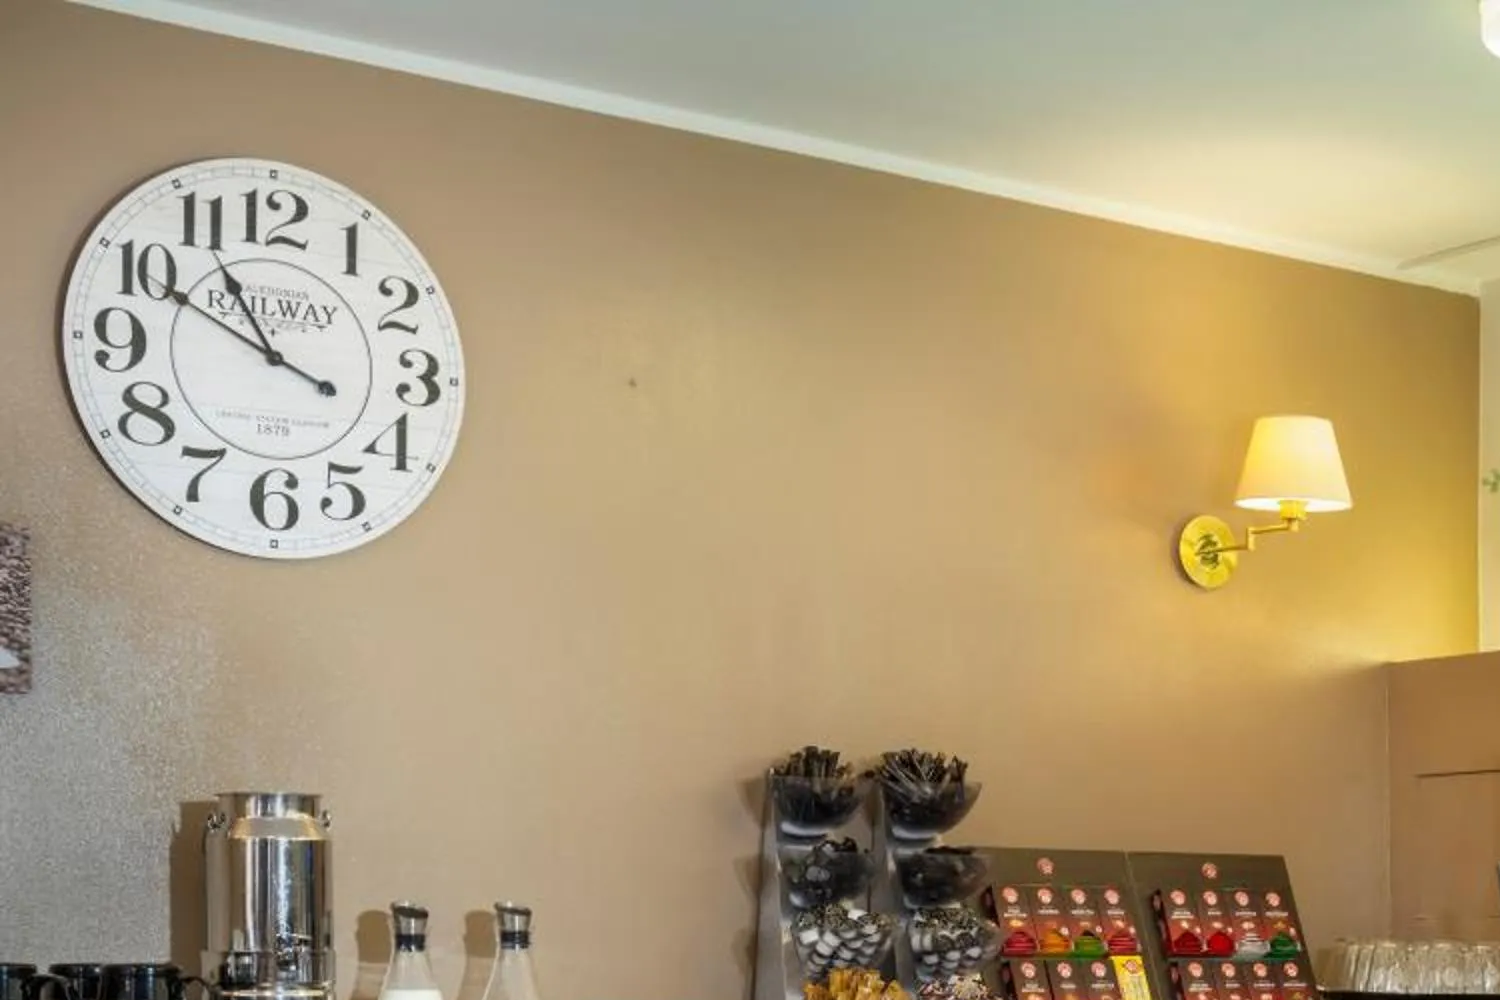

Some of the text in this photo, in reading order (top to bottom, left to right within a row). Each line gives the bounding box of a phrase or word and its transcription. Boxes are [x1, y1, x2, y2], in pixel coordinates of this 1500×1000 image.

[176, 191, 225, 252] 11
[239, 188, 309, 251] 12
[340, 222, 361, 278] 1
[116, 239, 177, 301] 10
[207, 289, 338, 325] RAILWAY
[377, 275, 420, 335] 2
[93, 306, 147, 373] 9
[395, 348, 441, 407] 3
[117, 381, 176, 446] 8
[362, 412, 420, 473] 4
[180, 445, 227, 503] 7
[249, 467, 300, 532] 6
[320, 461, 367, 521] 5
